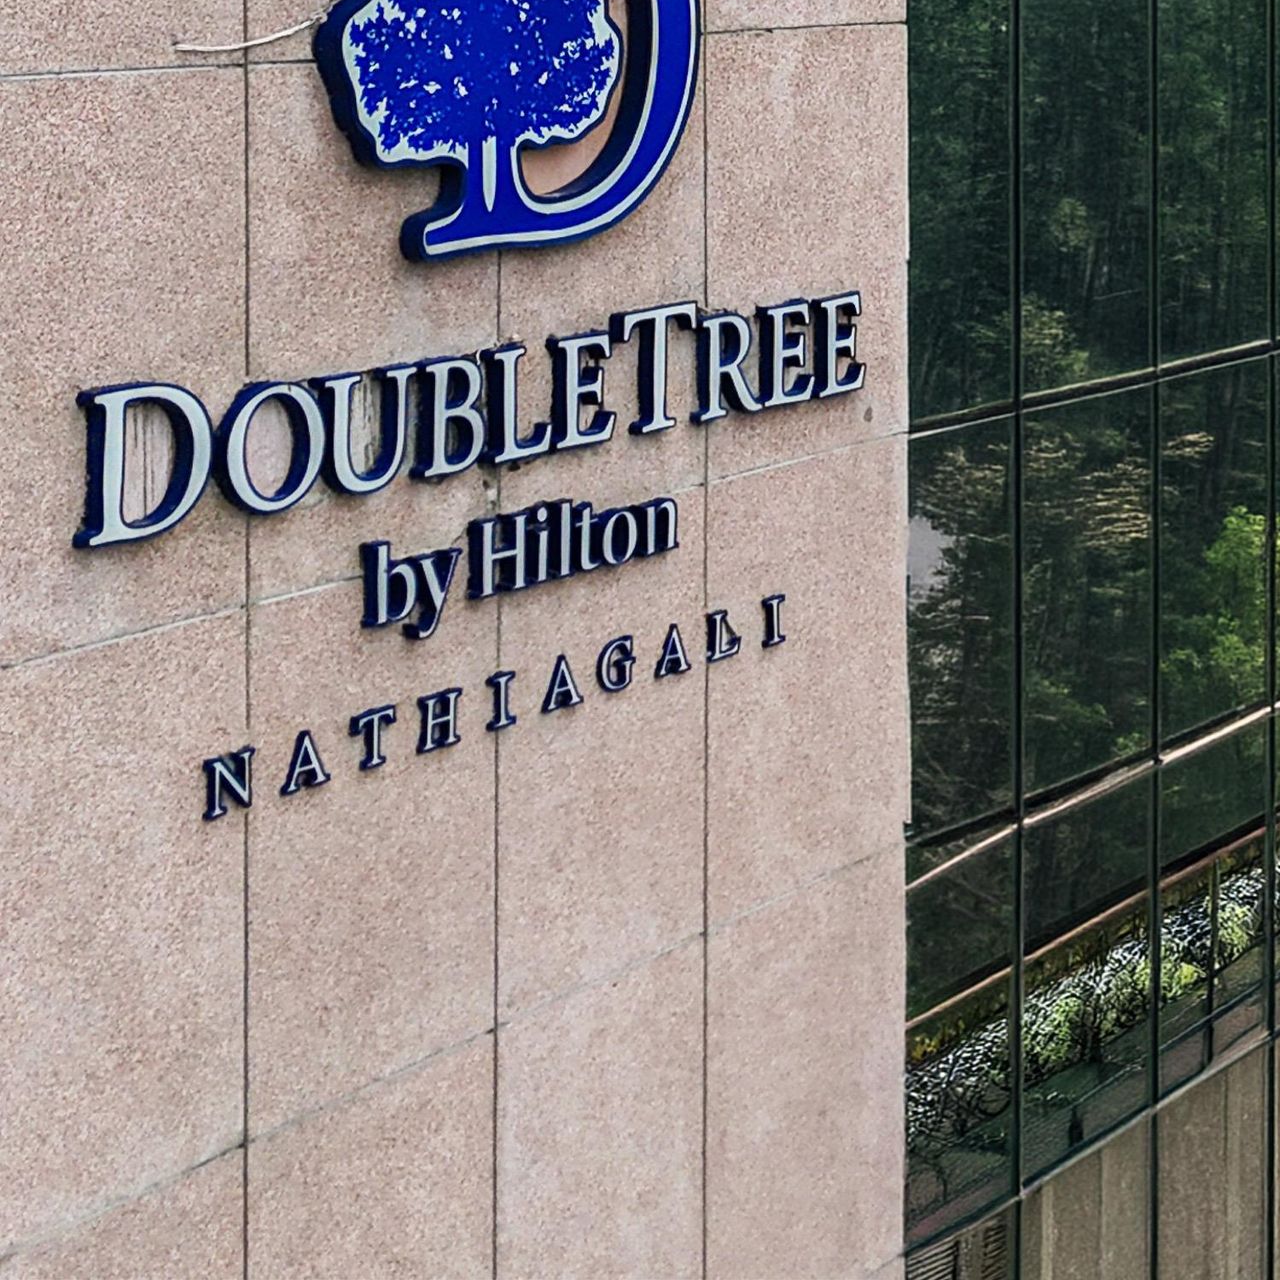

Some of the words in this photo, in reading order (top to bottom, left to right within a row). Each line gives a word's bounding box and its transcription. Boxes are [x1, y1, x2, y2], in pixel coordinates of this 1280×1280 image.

[361, 539, 460, 638] by
[466, 497, 678, 600] Hilton
[203, 595, 786, 820] NATHIAGALI
